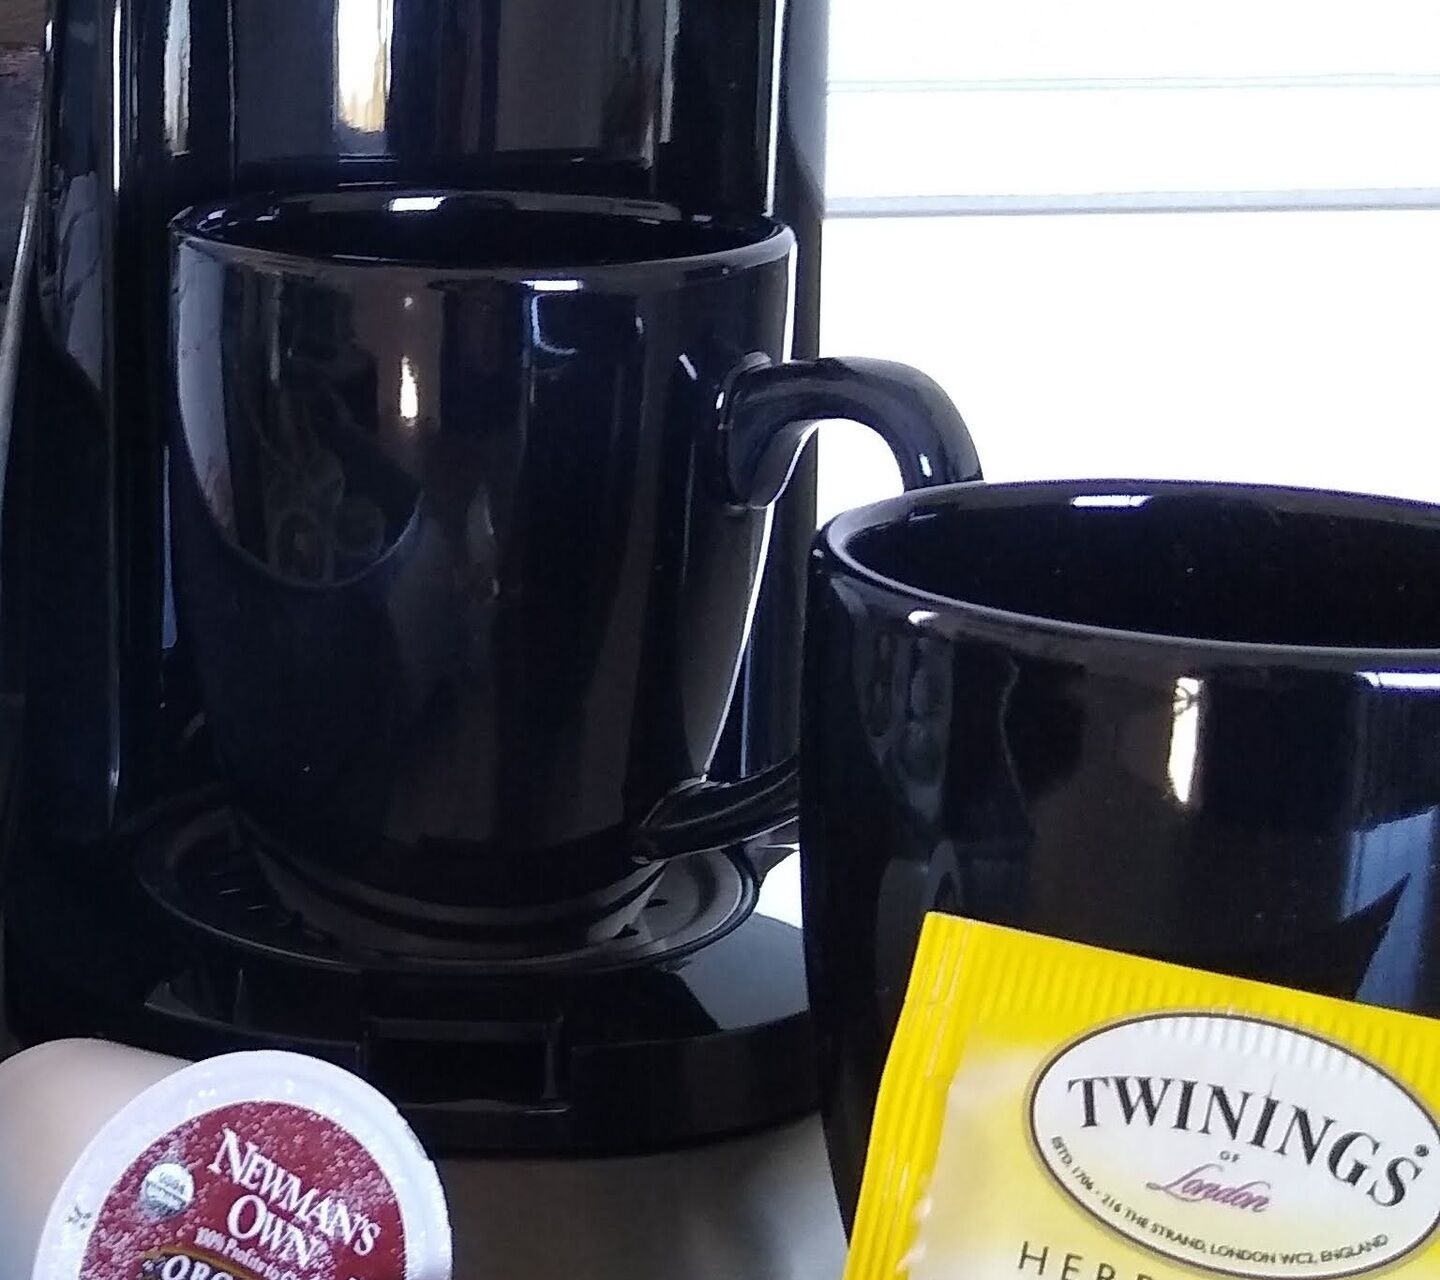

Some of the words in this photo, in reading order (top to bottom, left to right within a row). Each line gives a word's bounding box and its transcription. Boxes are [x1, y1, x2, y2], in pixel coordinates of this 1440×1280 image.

[207, 1127, 382, 1257] NEWMAN'S
[1067, 1075, 1424, 1209] TWININGS
[1146, 1163, 1272, 1214] London
[227, 1195, 321, 1268] OWN
[1070, 1164, 1095, 1193] 1706
[1101, 1192, 1124, 1214] 216
[1125, 1207, 1150, 1229] THE
[1210, 1241, 1277, 1266] LONDON
[1320, 1232, 1390, 1264] ENGLAND
